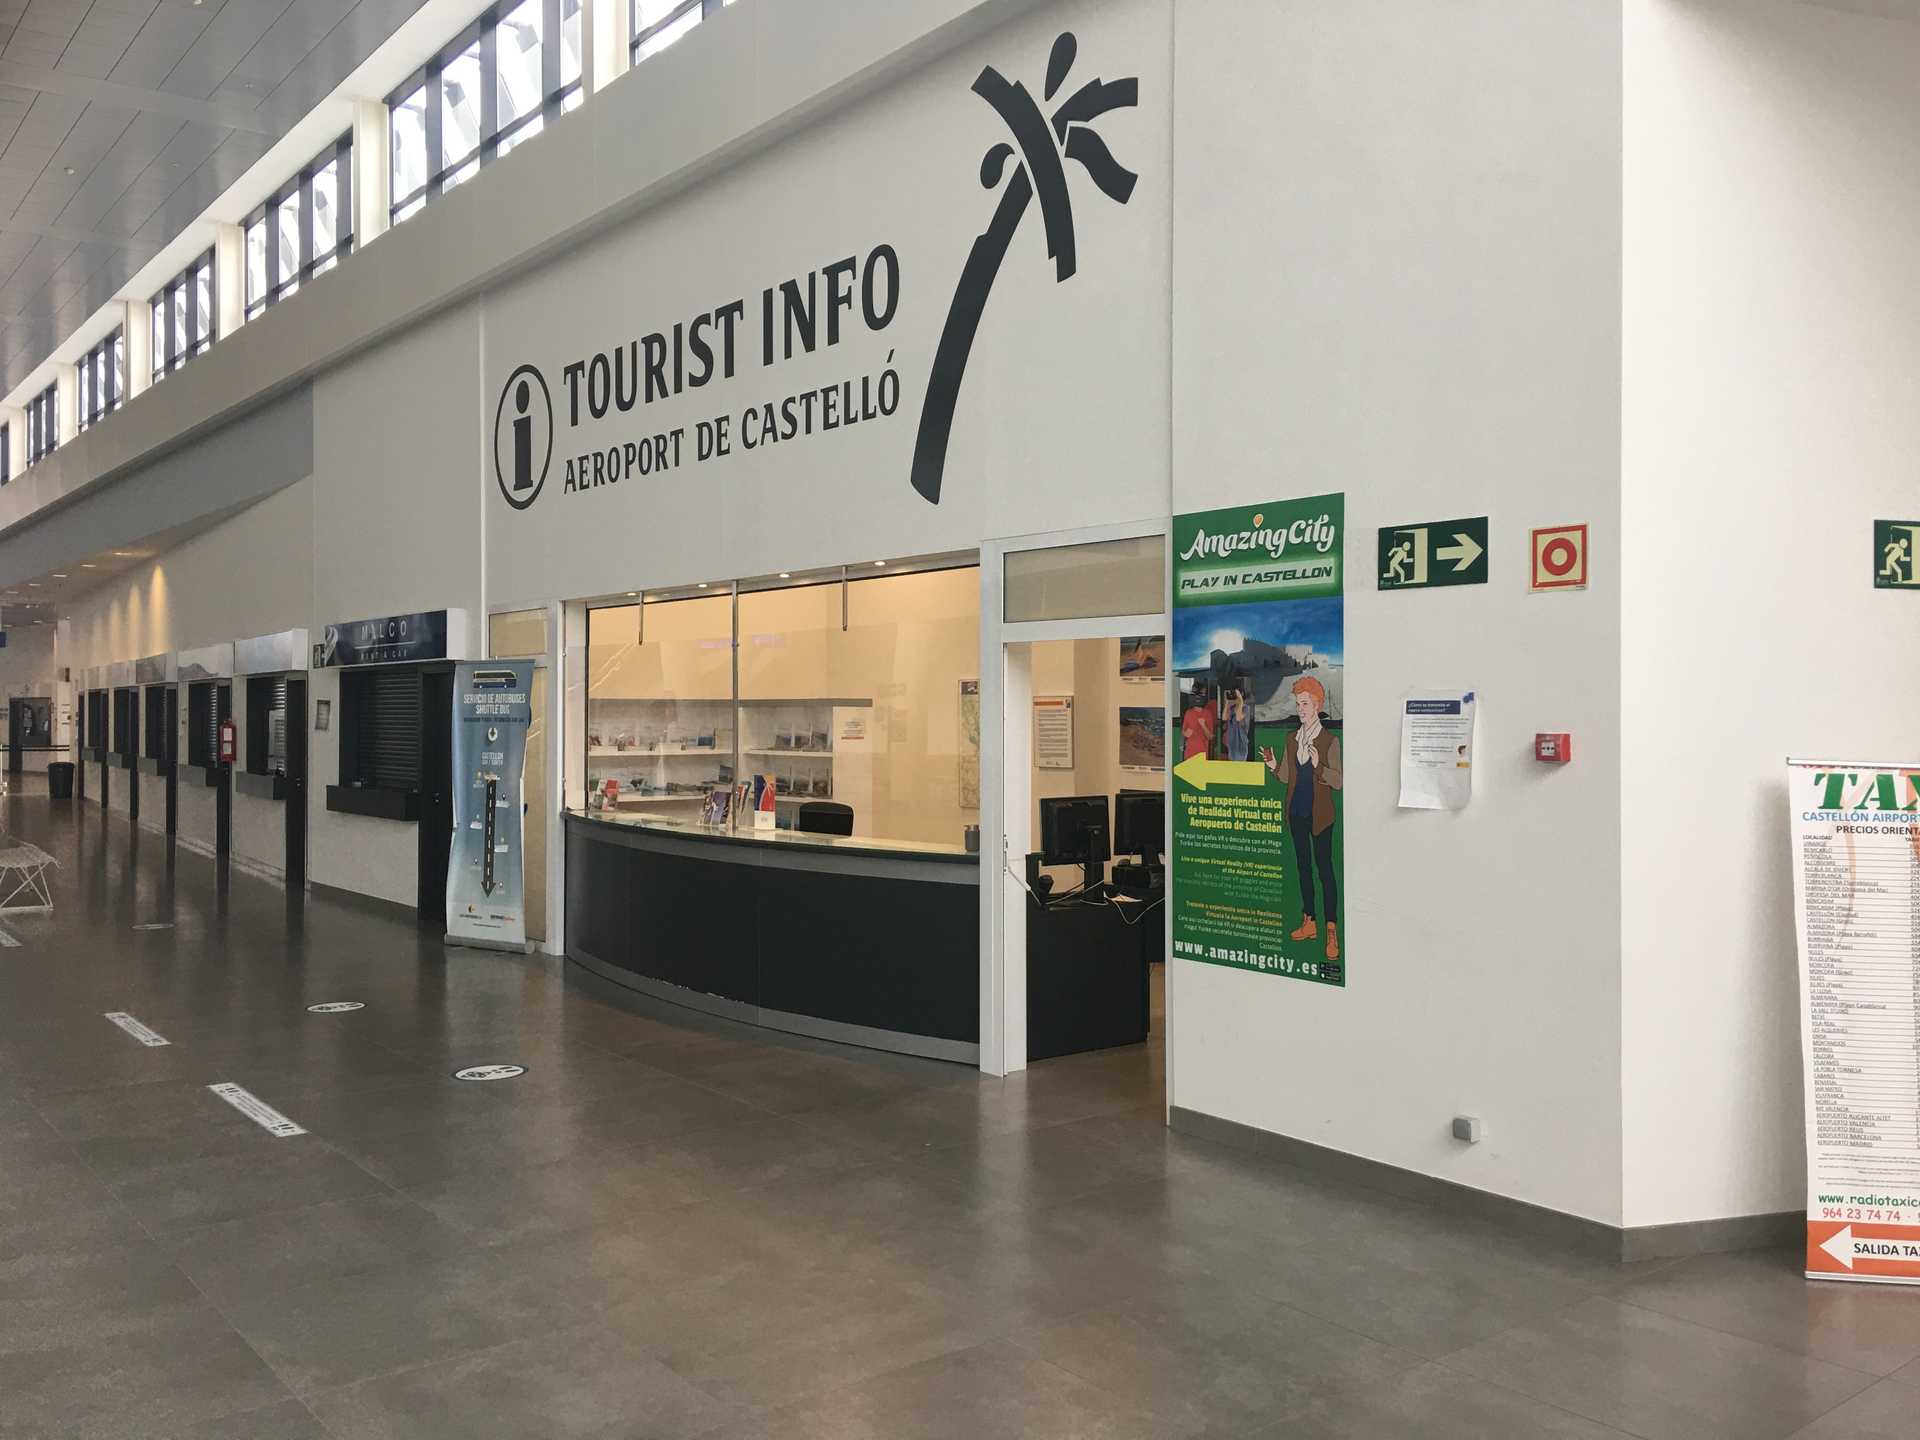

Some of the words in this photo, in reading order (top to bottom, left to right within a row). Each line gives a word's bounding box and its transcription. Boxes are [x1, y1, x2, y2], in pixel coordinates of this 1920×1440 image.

[563, 298, 744, 427] TOURIST
[762, 243, 901, 367] INFO
[563, 428, 685, 495] AEROPORT
[695, 414, 732, 462] DE
[741, 348, 901, 450] CASTELLÓ
[1181, 576, 1220, 590] PLAY
[1223, 574, 1238, 586] IN
[1241, 565, 1334, 584] CASTELLON
[475, 703, 499, 715] SHUTTLE
[499, 703, 510, 715] BUS
[1180, 793, 1197, 804] Vive
[1198, 795, 1213, 805] una
[1214, 796, 1259, 807] experiencia
[1259, 798, 1282, 809] única
[1187, 804, 1198, 815] de
[1199, 806, 1232, 818] Realidad
[1233, 808, 1260, 820] Virtual
[1261, 811, 1272, 821] en
[1273, 811, 1282, 821] el
[1802, 811, 1869, 822] CASTELLÓN
[1190, 816, 1233, 829] Aeropuerto
[1233, 820, 1244, 830] de
[1245, 821, 1282, 833] Castellón
[1836, 825, 1879, 835] PRECIOS
[1881, 826, 1920, 836] ORIENT
[1175, 940, 1318, 975] www.amazingcity.es
[1818, 1195, 1920, 1208] www.radiotaxic
[1822, 1207, 1842, 1219] 964
[1847, 1208, 1862, 1220] 23
[1866, 1209, 1882, 1221] 74
[1886, 1210, 1901, 1222] 74
[1853, 1242, 1900, 1256] SALIDA
[1903, 1245, 1920, 1257] TA
